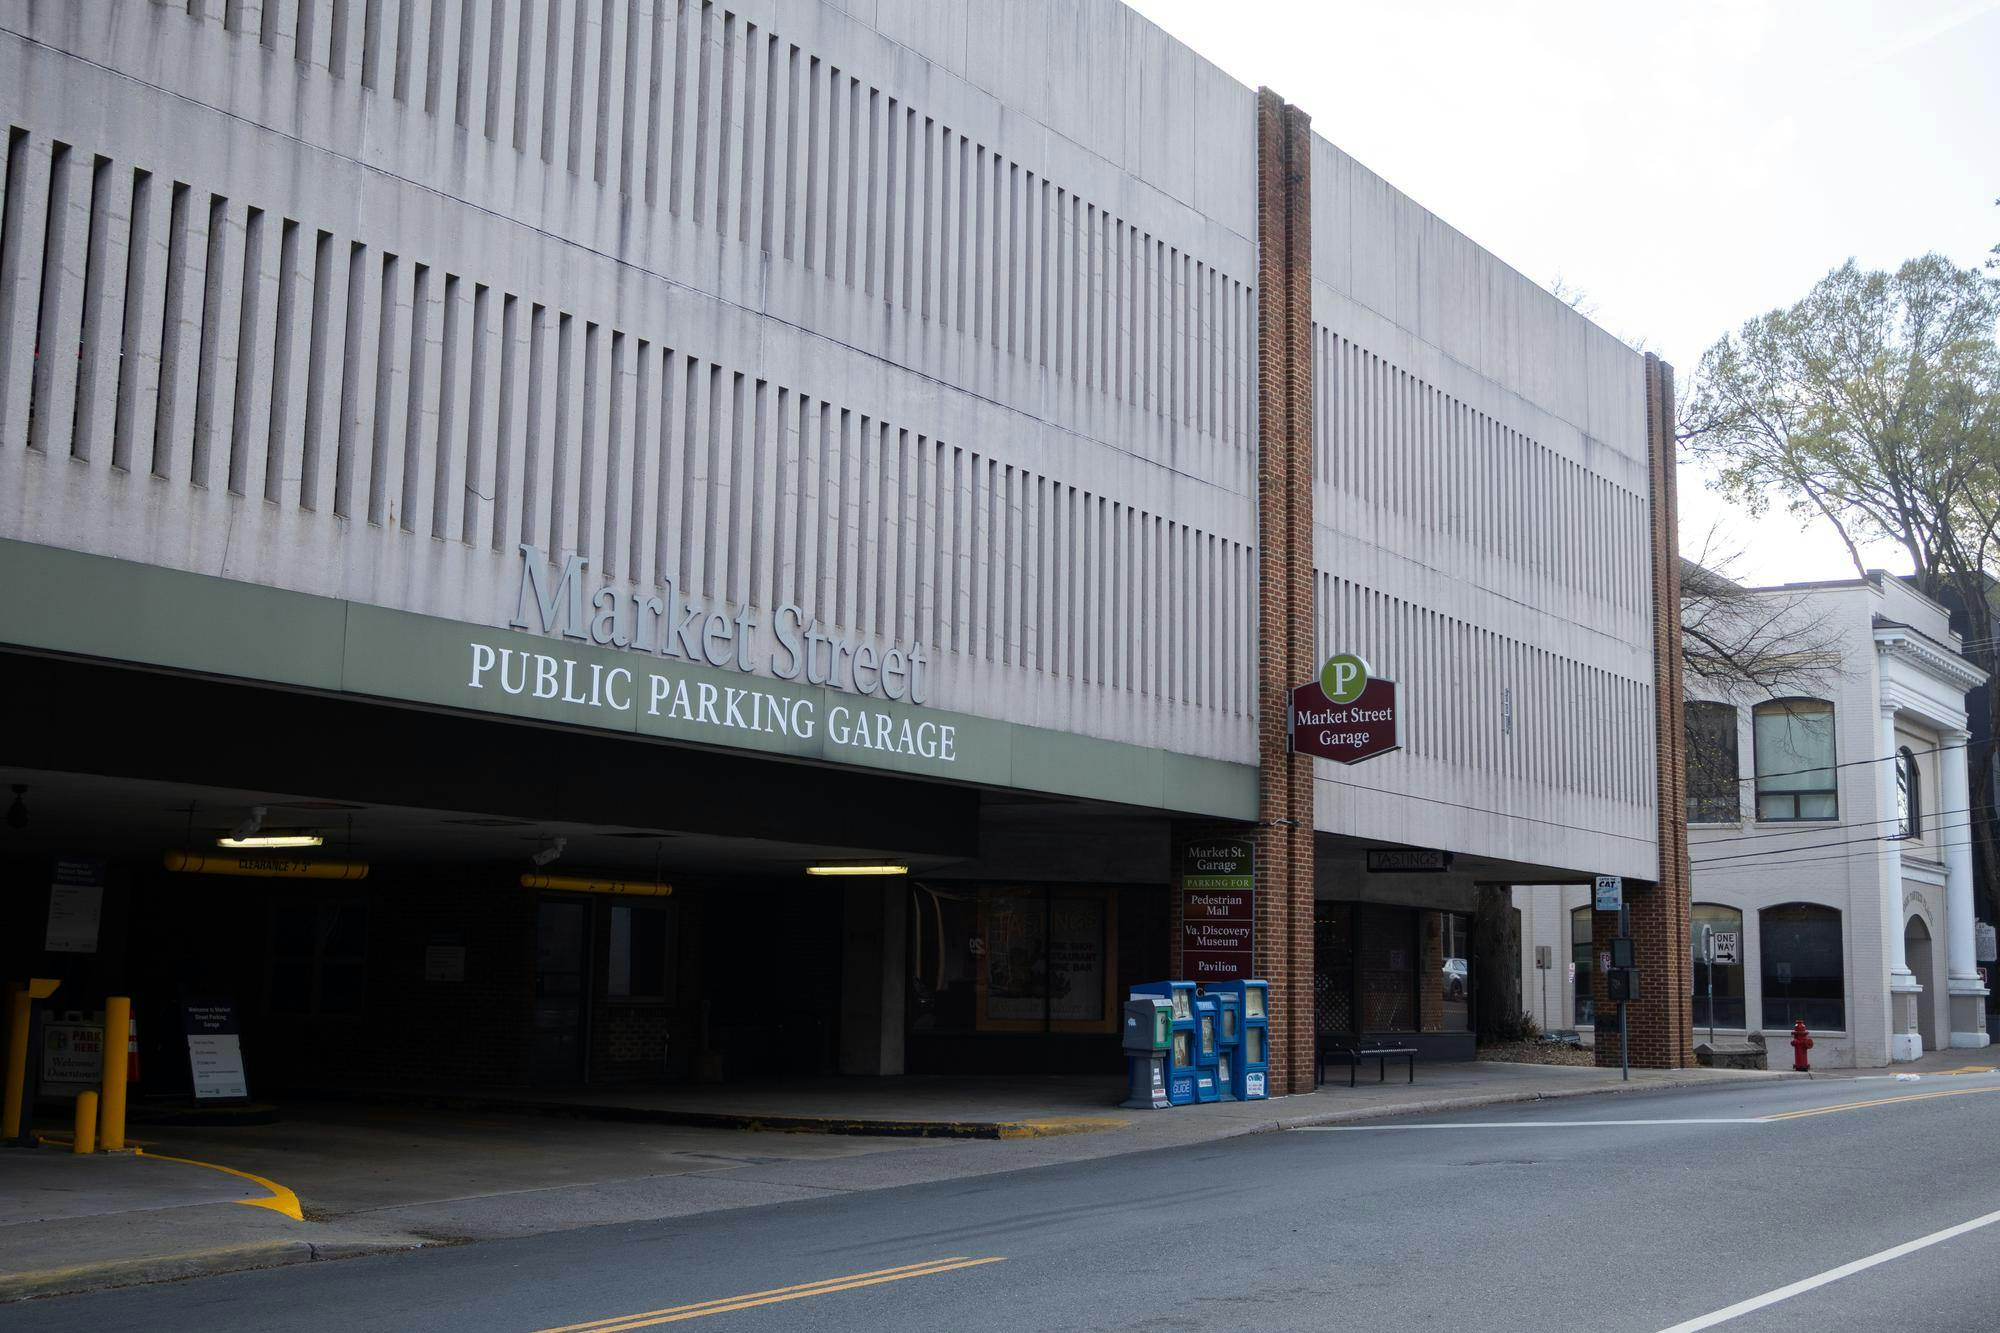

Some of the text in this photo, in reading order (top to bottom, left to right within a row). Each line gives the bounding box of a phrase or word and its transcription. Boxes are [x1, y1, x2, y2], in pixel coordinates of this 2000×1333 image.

[510, 543, 927, 705] Market Street
[1332, 662, 1357, 696] P
[468, 642, 958, 762] PUBLIC PARKING GARAGE
[1297, 707, 1393, 725] Market Street
[1319, 730, 1370, 748] Garage
[1188, 846, 1245, 858] Market St.
[1196, 859, 1237, 873] Garage
[1187, 879, 1249, 887] PARKING FOR
[1599, 881, 1616, 889] CAT
[1191, 895, 1242, 905] Pedestrian
[1206, 905, 1229, 916] Mall
[1185, 925, 1250, 938] Va. Discovery
[1197, 936, 1238, 946] Museum
[1716, 934, 1735, 943] ONE
[1717, 943, 1735, 951] WAY
[1198, 961, 1238, 972] Pavilion
[73, 1030, 102, 1041] PARK
[74, 1043, 100, 1053] HERE
